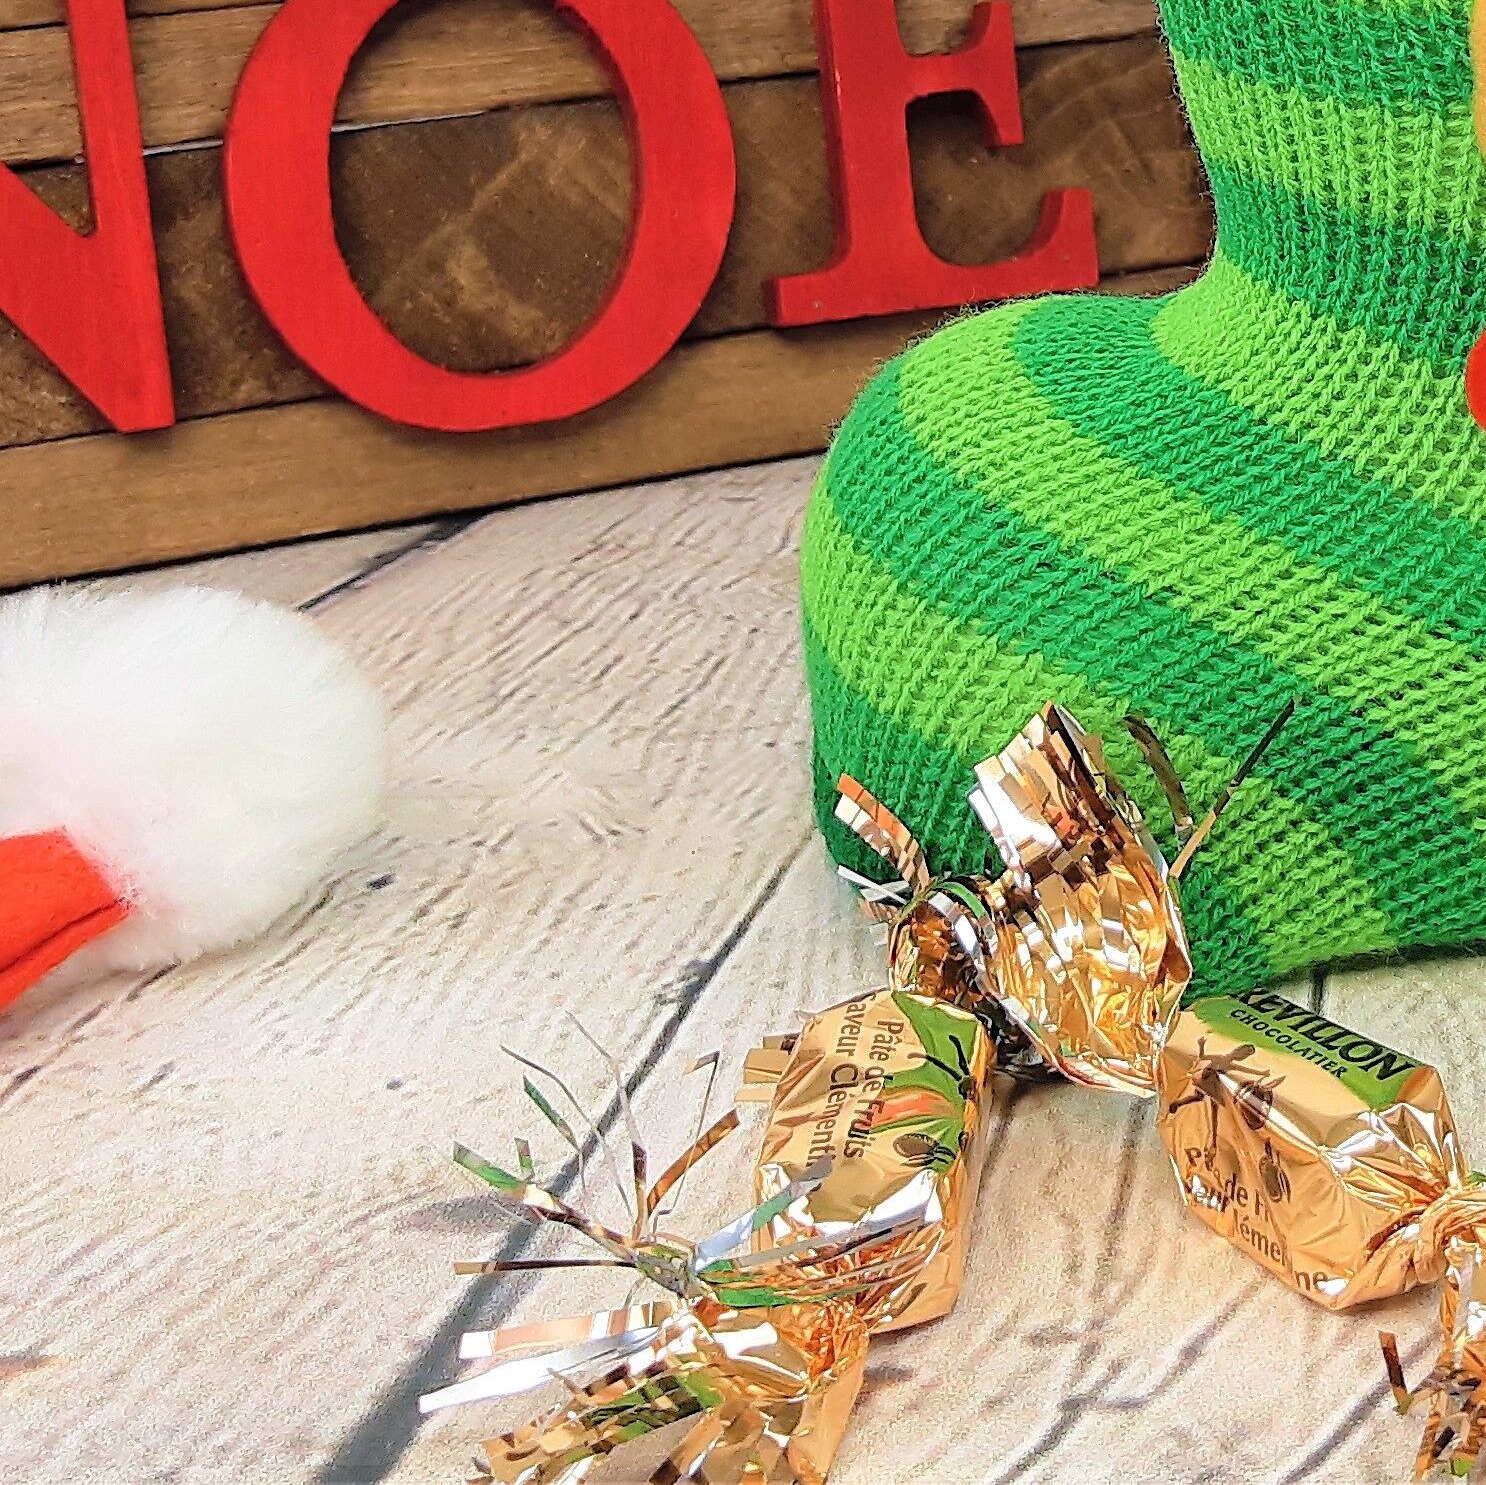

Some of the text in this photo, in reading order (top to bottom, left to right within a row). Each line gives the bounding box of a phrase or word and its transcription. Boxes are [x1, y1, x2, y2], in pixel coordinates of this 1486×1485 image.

[843, 1019, 904, 1159] Pâte de Fruits
[1230, 1008, 1349, 1080] CHOCOLATIER
[805, 1062, 859, 1167] Clémenti
